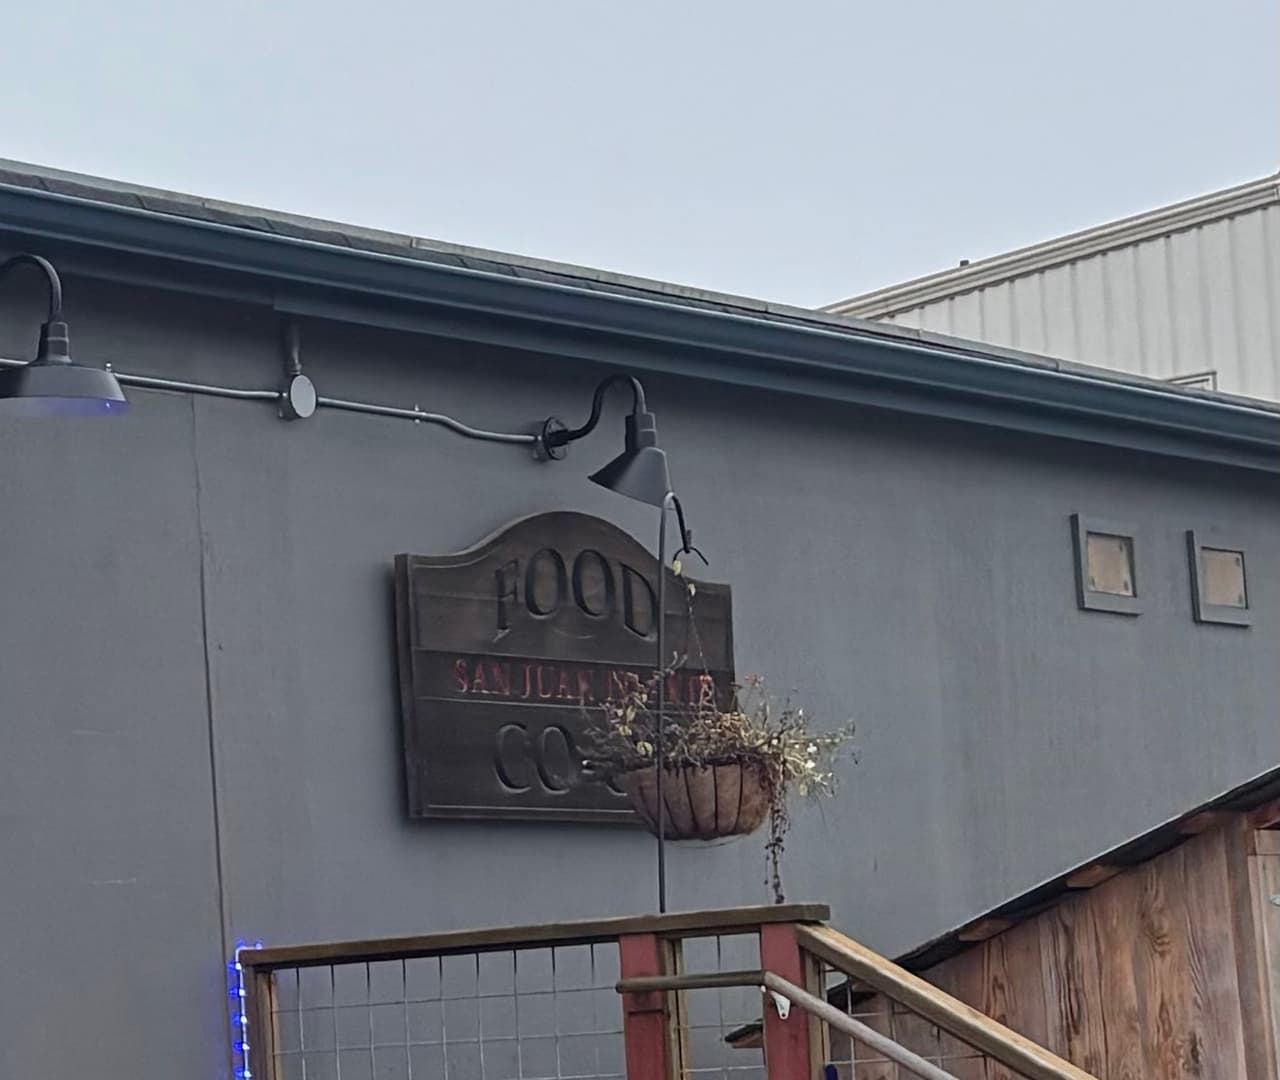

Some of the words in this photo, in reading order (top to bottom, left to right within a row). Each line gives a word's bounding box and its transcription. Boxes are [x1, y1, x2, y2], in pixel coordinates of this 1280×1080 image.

[493, 546, 660, 643] FOOD
[451, 657, 511, 696] SAN
[518, 662, 596, 702] JUAN
